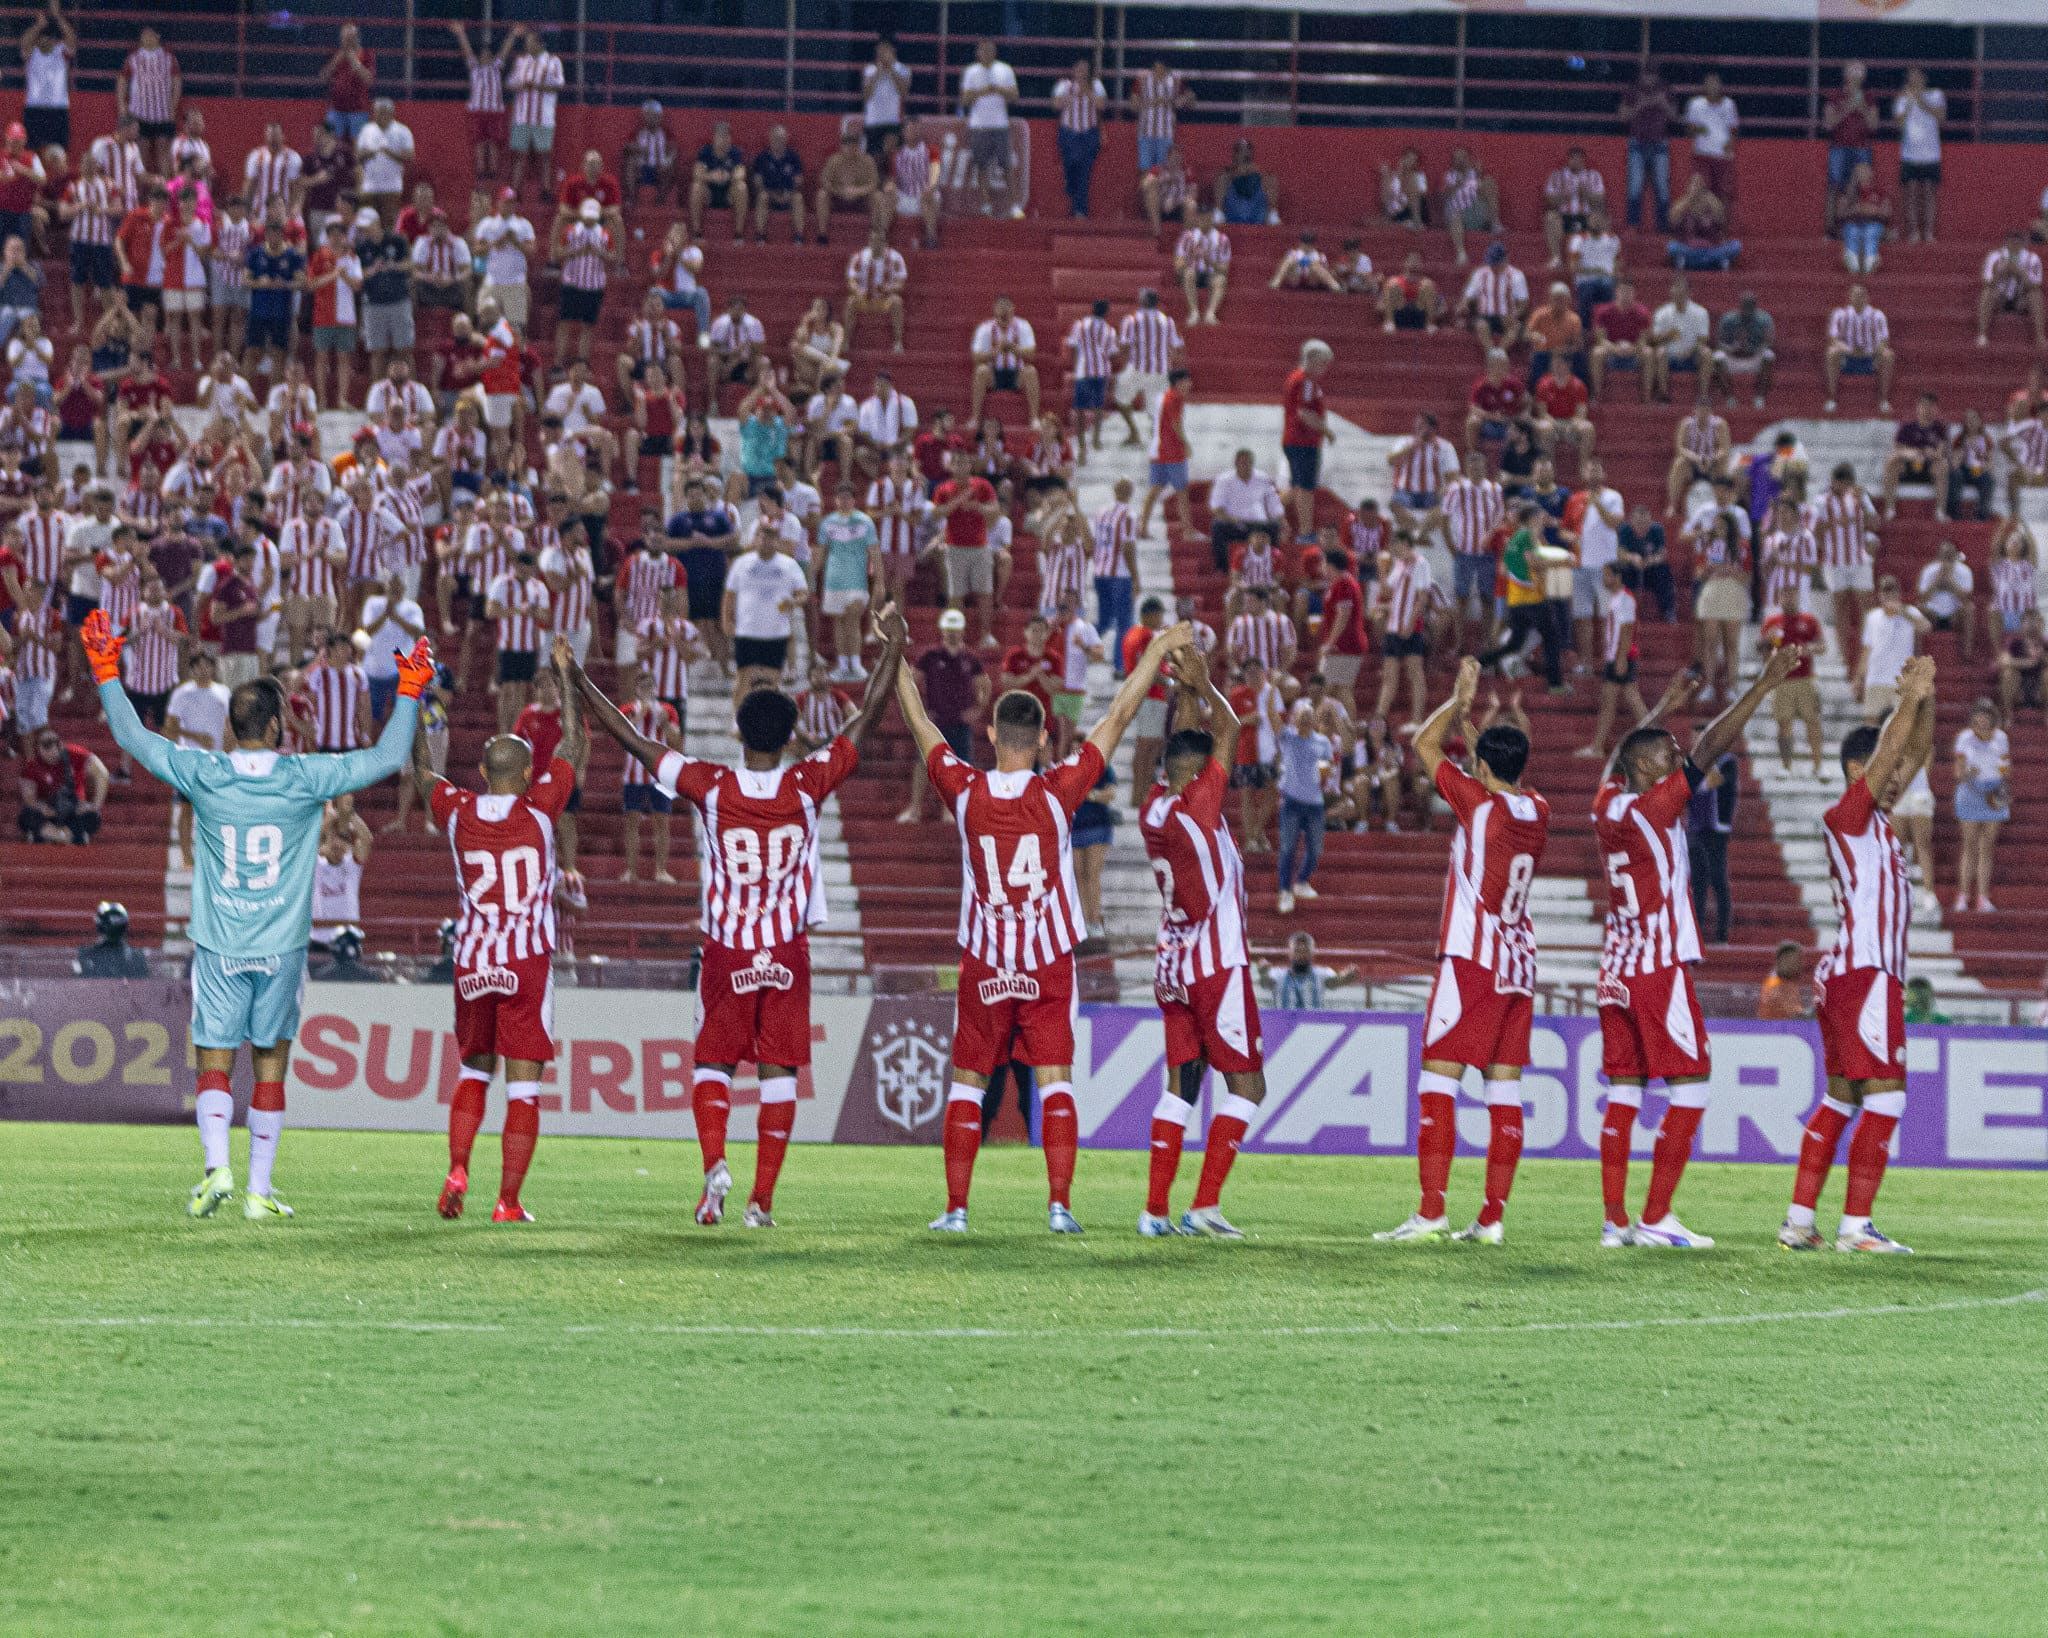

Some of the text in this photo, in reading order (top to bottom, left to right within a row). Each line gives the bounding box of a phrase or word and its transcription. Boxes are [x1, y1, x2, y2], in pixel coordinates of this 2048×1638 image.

[221, 824, 283, 891] 19
[463, 845, 540, 915] 20
[722, 823, 804, 885] 80
[979, 832, 1048, 906] 14
[1501, 852, 1535, 926] 8
[1608, 850, 1641, 919] 5
[734, 966, 791, 989] DRAGÃO
[980, 978, 1038, 1000] DRAGÃO
[0, 1018, 198, 1110] 202
[293, 1013, 826, 1114] SURB
[1072, 1016, 1408, 1147] VVA
